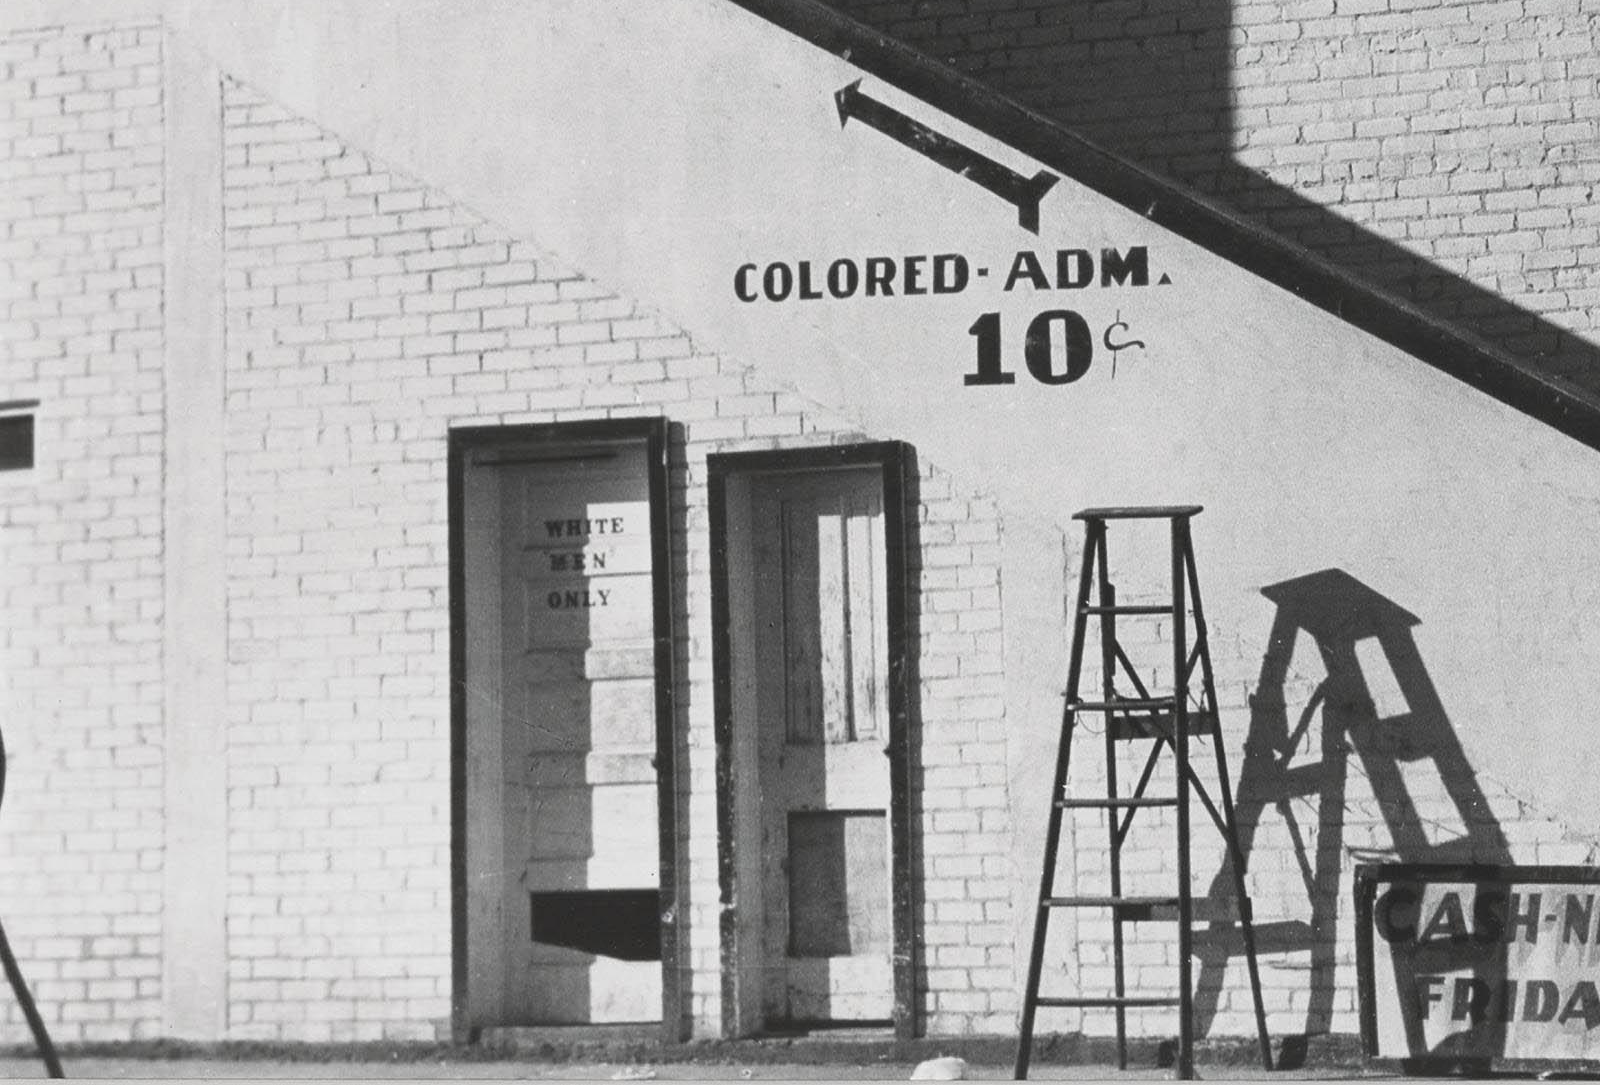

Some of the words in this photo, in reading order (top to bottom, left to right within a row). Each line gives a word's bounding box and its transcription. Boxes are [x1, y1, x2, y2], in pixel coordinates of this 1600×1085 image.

[544, 517, 624, 537] WHITE
[549, 553, 607, 571] MEN
[547, 589, 612, 609] ONLY
